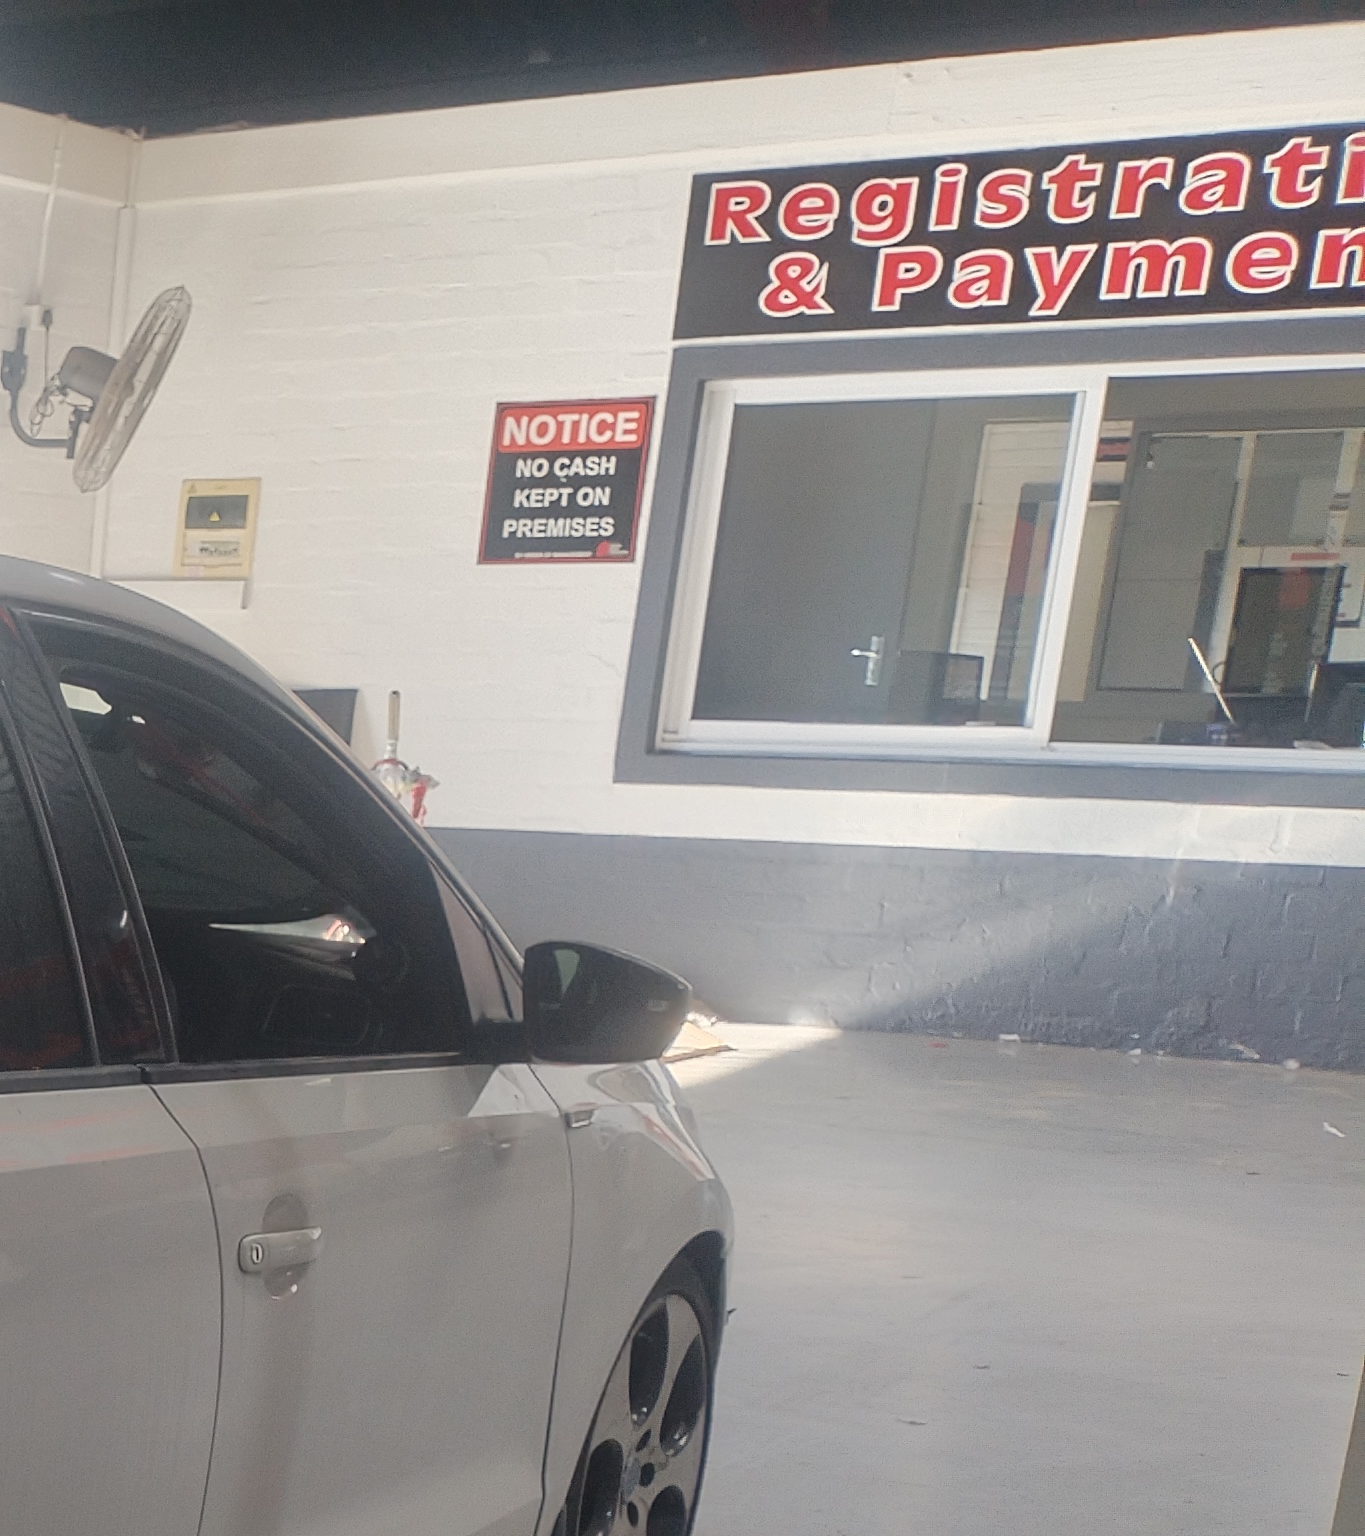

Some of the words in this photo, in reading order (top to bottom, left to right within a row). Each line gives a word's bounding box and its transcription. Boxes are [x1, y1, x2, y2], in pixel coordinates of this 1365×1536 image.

[703, 131, 1365, 247] Registrati
[758, 251, 835, 317] &
[871, 227, 1365, 317] Paymen
[502, 411, 641, 447] NOTICE
[515, 457, 550, 478] NO
[553, 455, 617, 477] CASH
[513, 487, 574, 508] KEPT
[575, 485, 612, 507] ON
[501, 516, 616, 538] PREMISES
